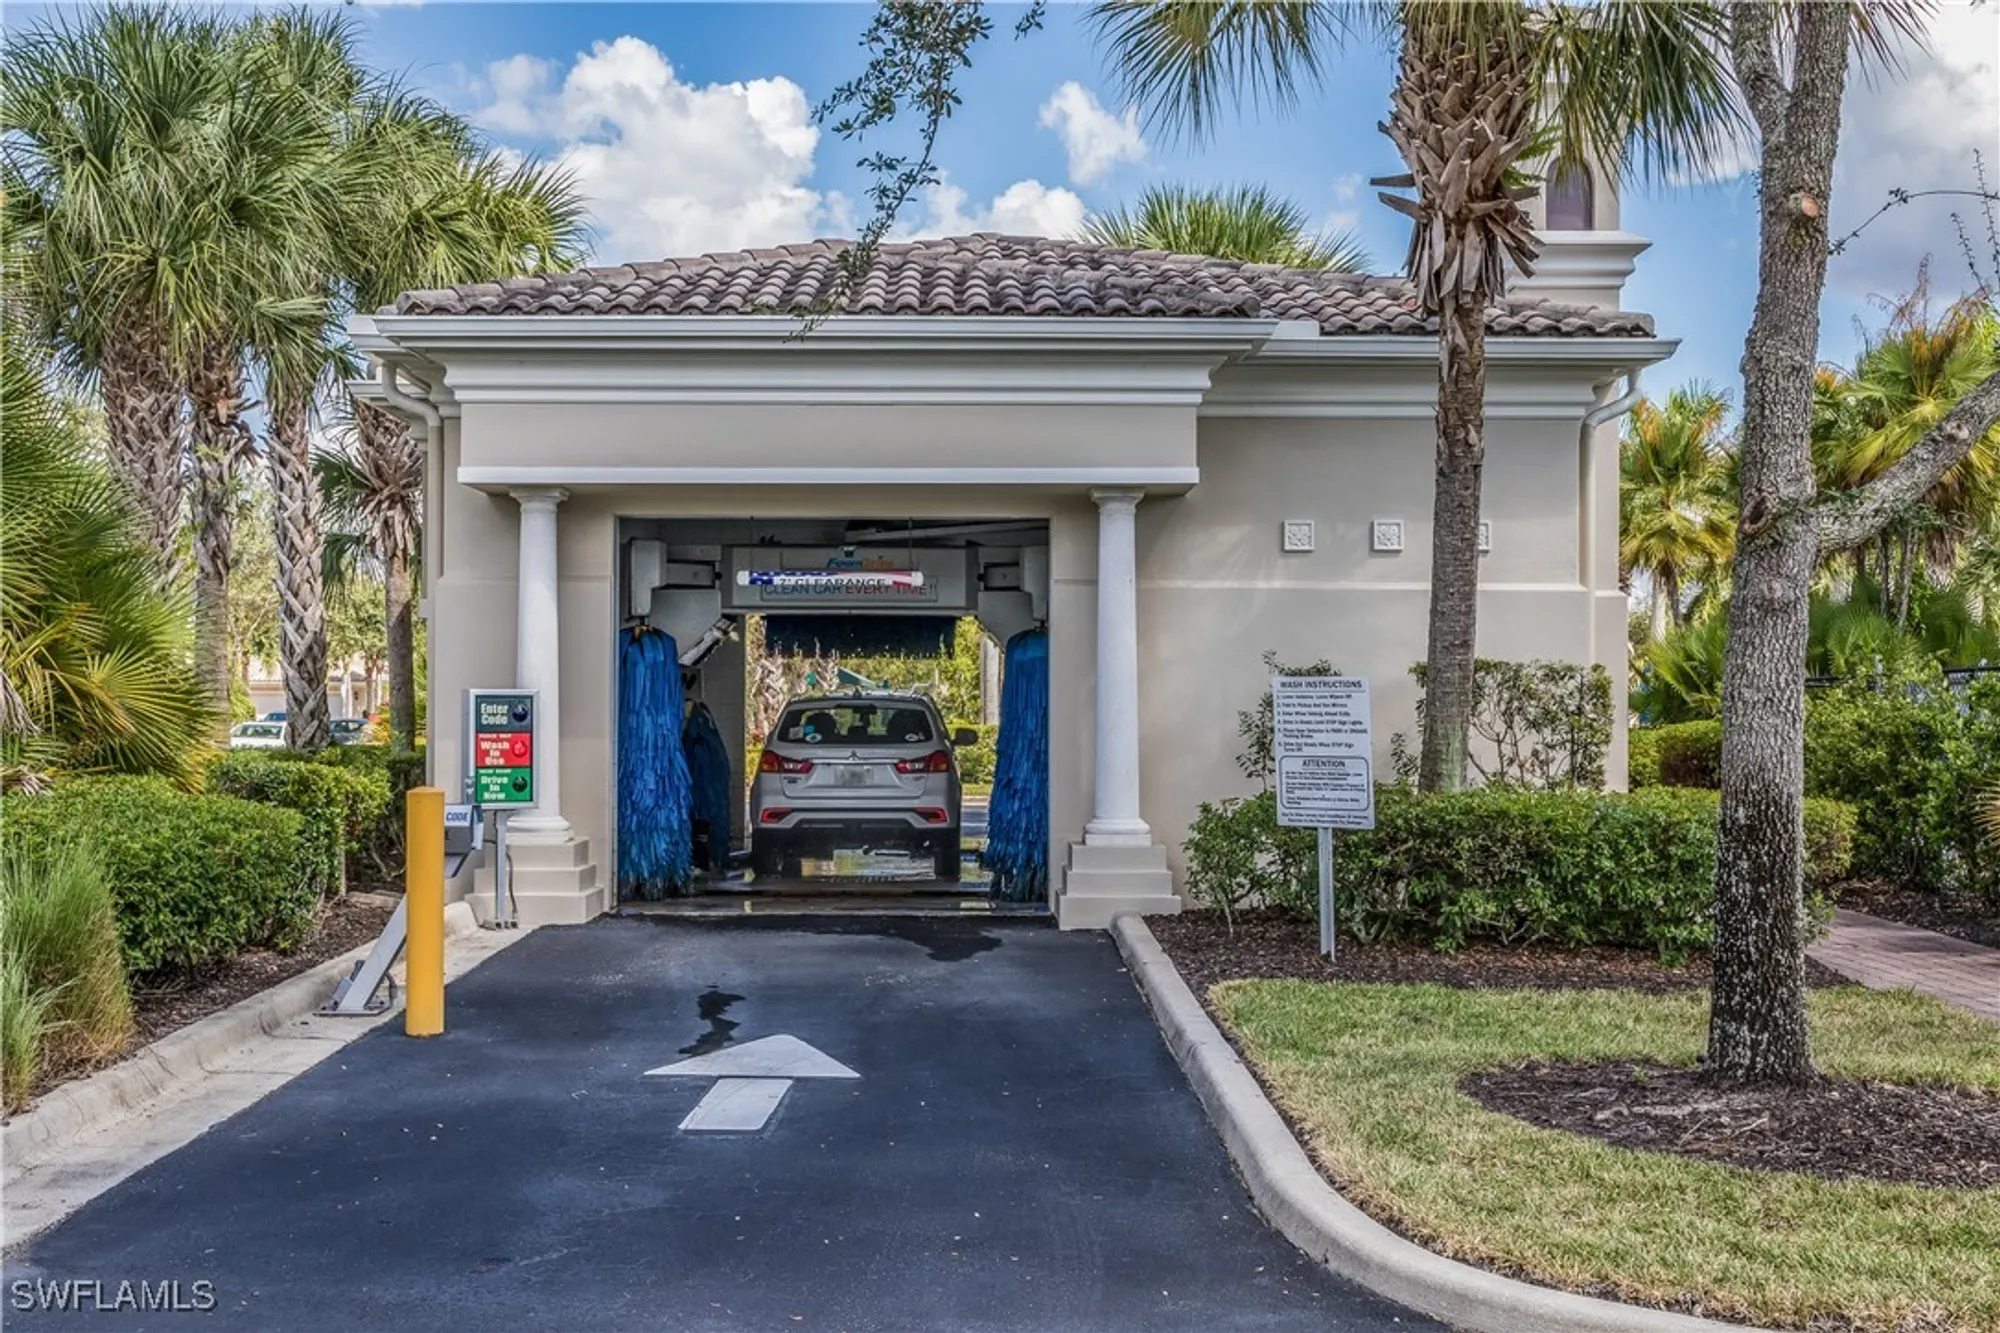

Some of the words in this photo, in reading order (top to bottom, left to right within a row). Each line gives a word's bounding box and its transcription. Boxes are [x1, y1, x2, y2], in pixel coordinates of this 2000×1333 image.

[795, 578, 885, 586] CLEARANCE
[764, 583, 808, 595] CLEAN
[812, 583, 842, 595] CAR
[845, 584, 890, 595] EVERY
[1280, 681, 1303, 689] WASH
[1304, 681, 1362, 689] INSTRUCTIONS
[480, 703, 509, 715] Enter
[480, 714, 508, 725] Code
[480, 740, 510, 751] Wash
[484, 757, 506, 766] Use
[1302, 760, 1346, 768] ATTENTION
[480, 775, 509, 785] Drive
[483, 792, 506, 800] Now
[445, 811, 469, 823] CODE
